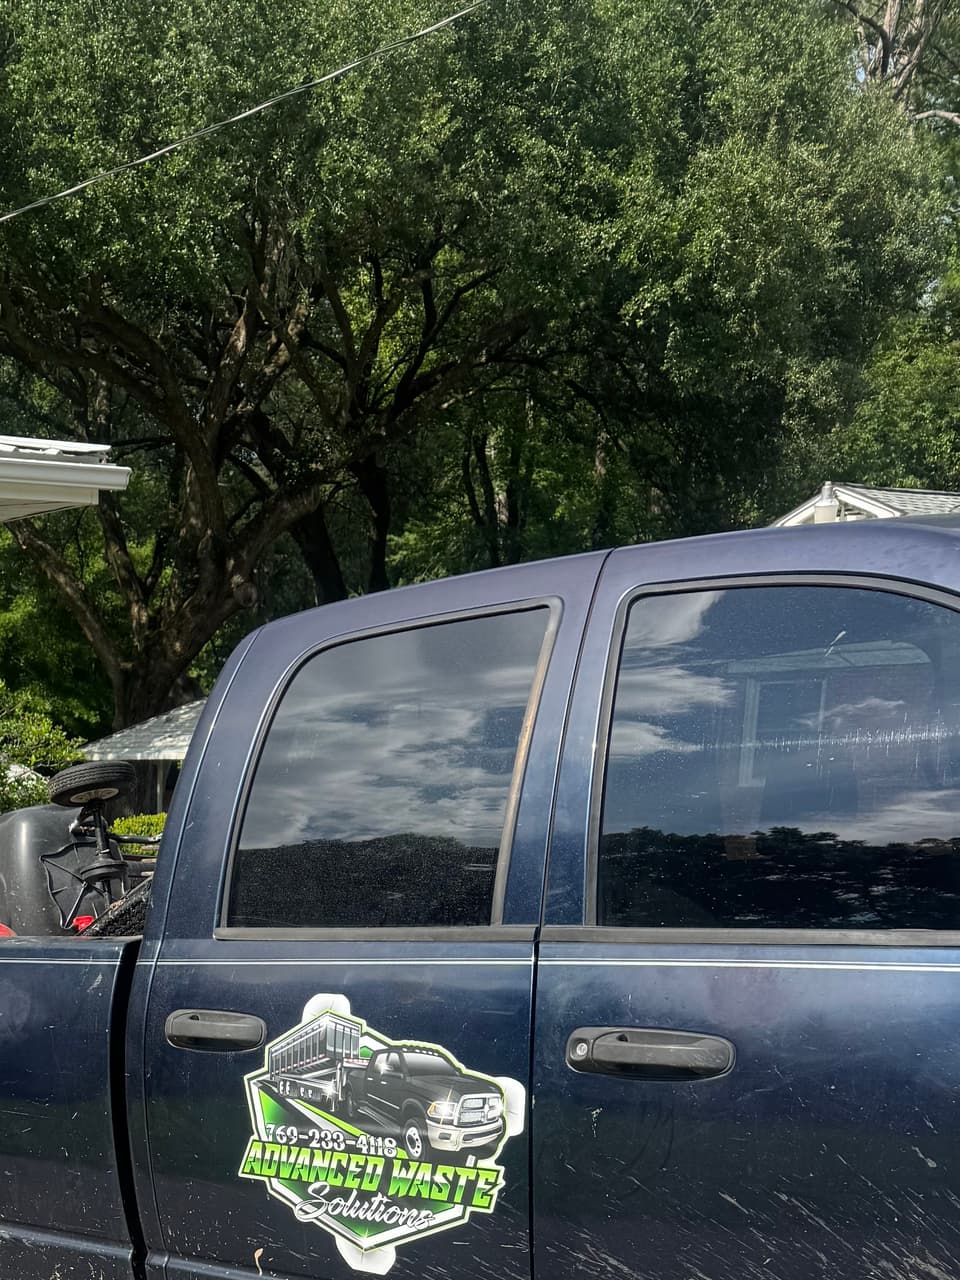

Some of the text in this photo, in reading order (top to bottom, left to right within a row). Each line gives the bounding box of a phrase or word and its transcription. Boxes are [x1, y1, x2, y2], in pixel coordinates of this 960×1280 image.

[265, 1124, 398, 1157] 769-233-4118
[243, 1142, 500, 1207] ADVANCED WASTE
[295, 1182, 435, 1230] Solutions
